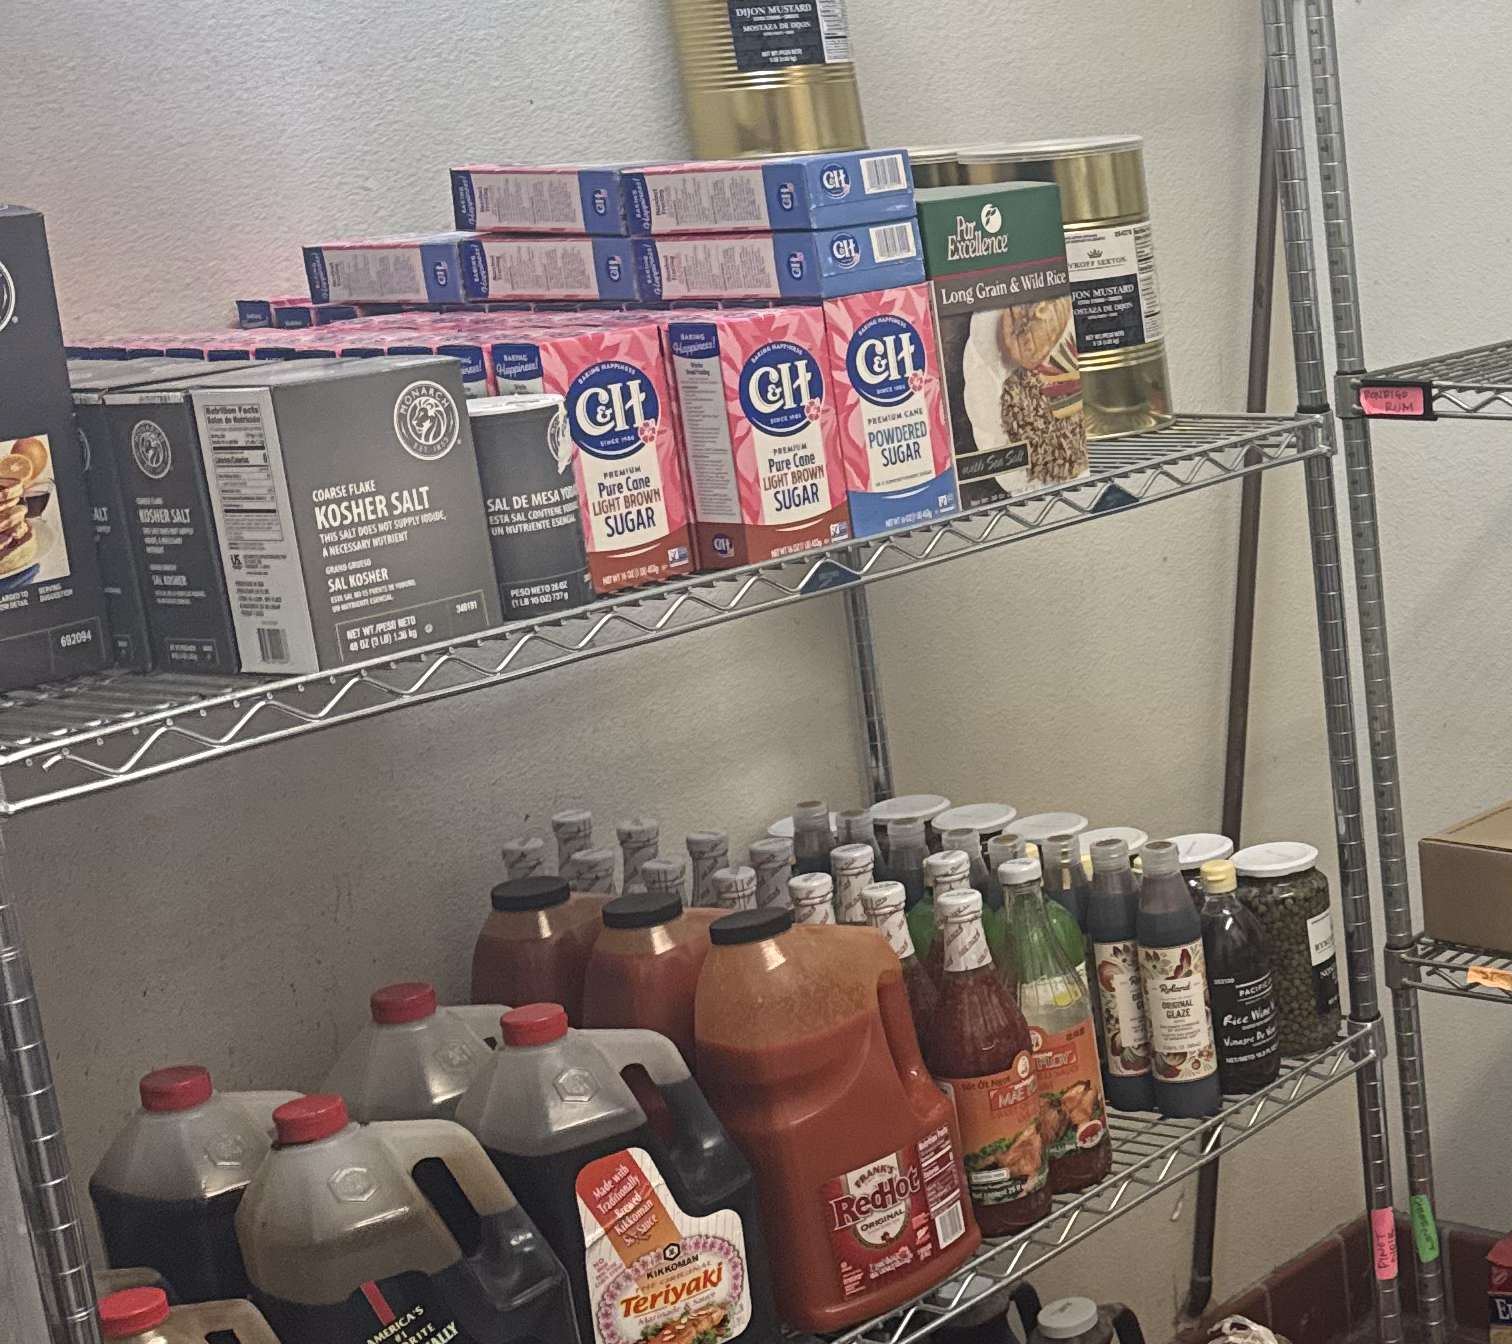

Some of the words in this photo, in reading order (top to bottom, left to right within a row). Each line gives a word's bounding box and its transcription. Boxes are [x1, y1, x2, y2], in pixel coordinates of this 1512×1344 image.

[956, 215, 976, 240] Par
[947, 231, 1009, 260] Excellence
[941, 288, 974, 305] Long
[976, 282, 1008, 298] Grain
[1009, 278, 1020, 293] &
[1020, 273, 1045, 290] Wild
[1046, 270, 1068, 285] Rice
[1094, 284, 1134, 299] MUSTARD
[856, 333, 915, 385] C&H
[400, 385, 449, 414] MONARCH
[748, 360, 812, 414] C&H
[576, 379, 647, 436] C&H
[867, 413, 902, 425] PREMIUM
[904, 408, 924, 419] CANE
[868, 421, 927, 449] POWDERED
[768, 456, 790, 473] Pure
[792, 452, 815, 467] Cane
[881, 444, 921, 467] SUGAR
[603, 466, 642, 479] PREMIUM
[763, 473, 789, 491] LIGHT
[791, 465, 825, 485] BROWN
[313, 486, 347, 502] COARSE
[349, 480, 376, 496] FLAKE
[487, 497, 510, 512] SAL
[512, 494, 528, 509] DE
[531, 490, 560, 507] MESA
[598, 481, 624, 499] Pure
[625, 476, 651, 491] Cane
[774, 482, 819, 511] SUGAR
[315, 495, 388, 529] KOSHER
[391, 486, 430, 515] SALT
[592, 499, 621, 517] LIGHT
[623, 488, 661, 509] BROWN
[319, 532, 338, 544] THIS
[339, 529, 356, 540] SALT
[358, 525, 377, 535] DOES
[604, 506, 656, 537] SUGAR
[328, 576, 348, 592] SAL
[350, 568, 389, 588] KOSHER
[1166, 1009, 1191, 1019] GLAZE
[592, 1183, 614, 1199] Made
[612, 1164, 630, 1185] with
[596, 1174, 640, 1215] Traditionally
[614, 1192, 643, 1218] Brewed
[829, 1165, 920, 1232] RedHot
[615, 1199, 654, 1235] Kikkoman
[861, 1208, 905, 1232] ORIGINAL
[646, 1254, 699, 1280] KIKKOMAN
[620, 1261, 724, 1318] Teriyaki
